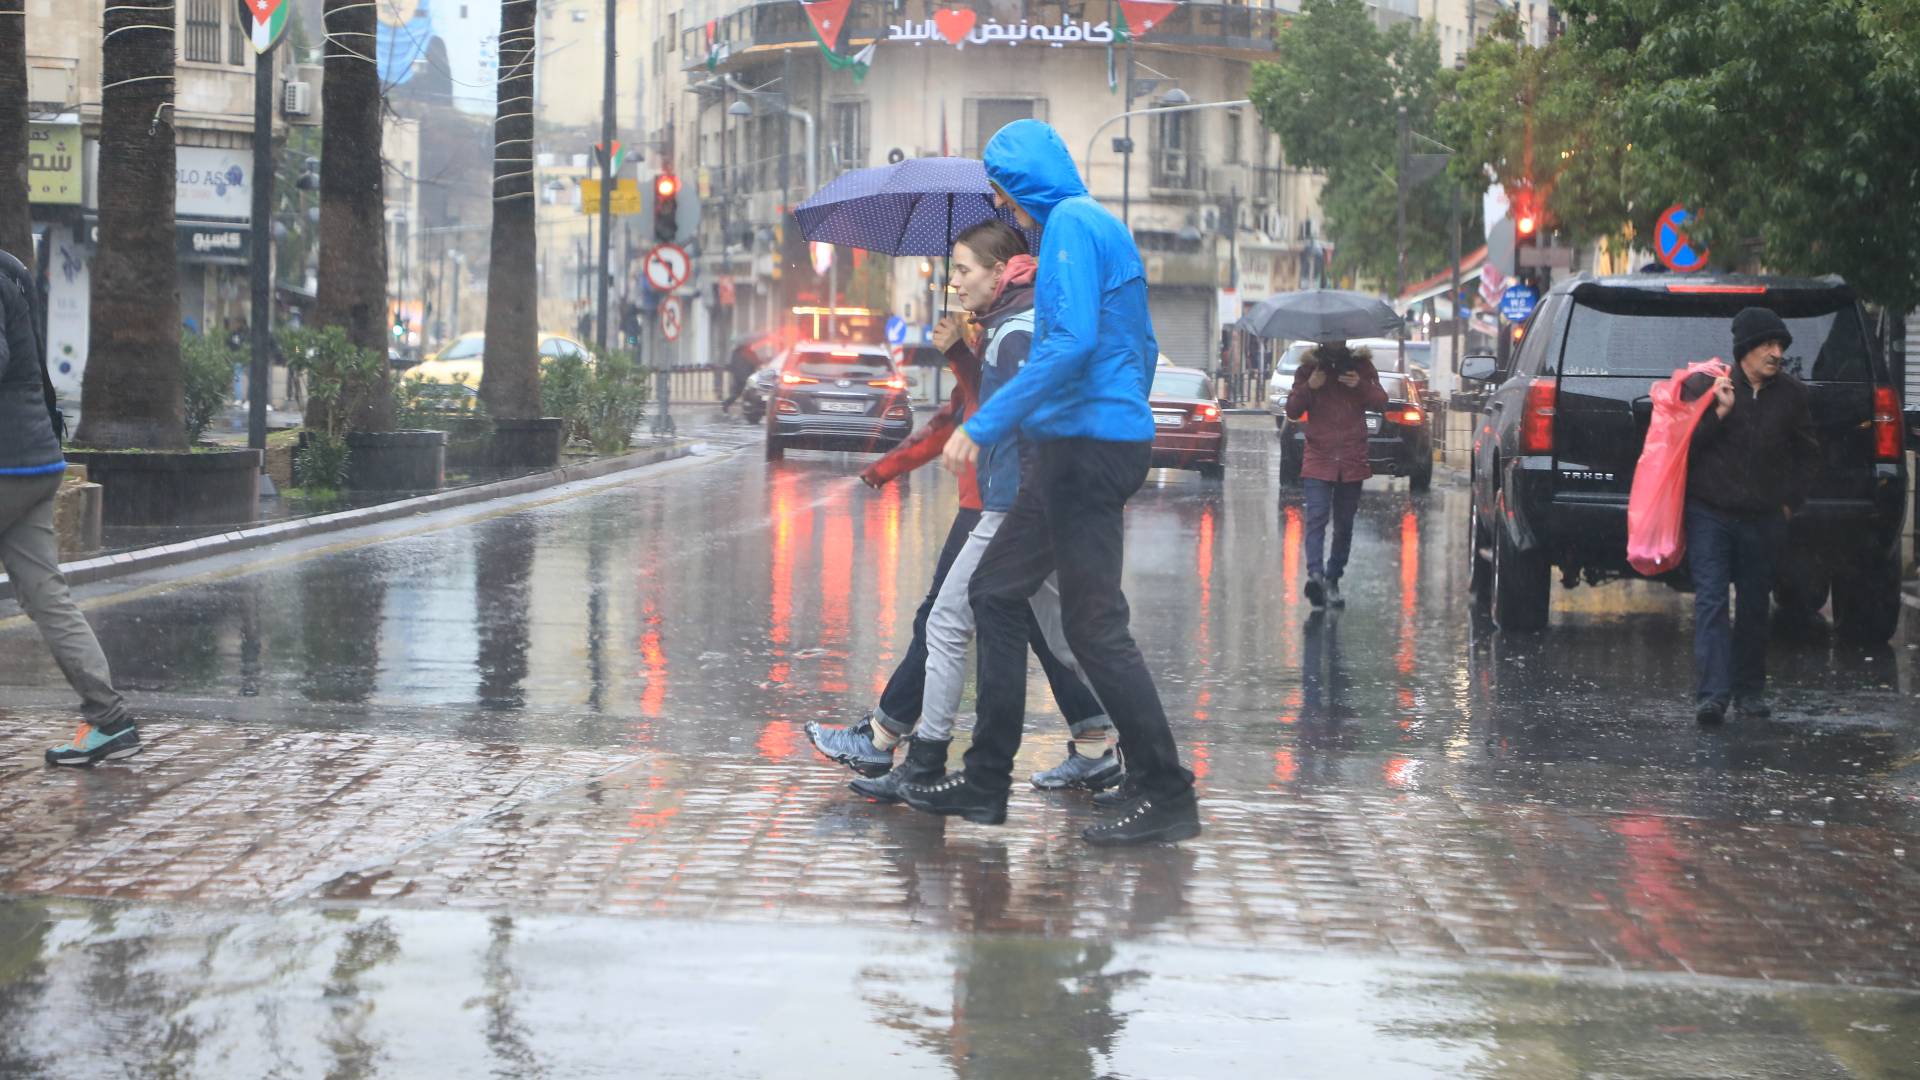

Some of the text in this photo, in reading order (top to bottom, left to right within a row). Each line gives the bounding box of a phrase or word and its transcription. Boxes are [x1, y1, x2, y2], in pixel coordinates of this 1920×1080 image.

[968, 17, 1028, 47] نبض
[1030, 20, 1114, 48] كافيه
[1562, 471, 1615, 481] TAHOE
